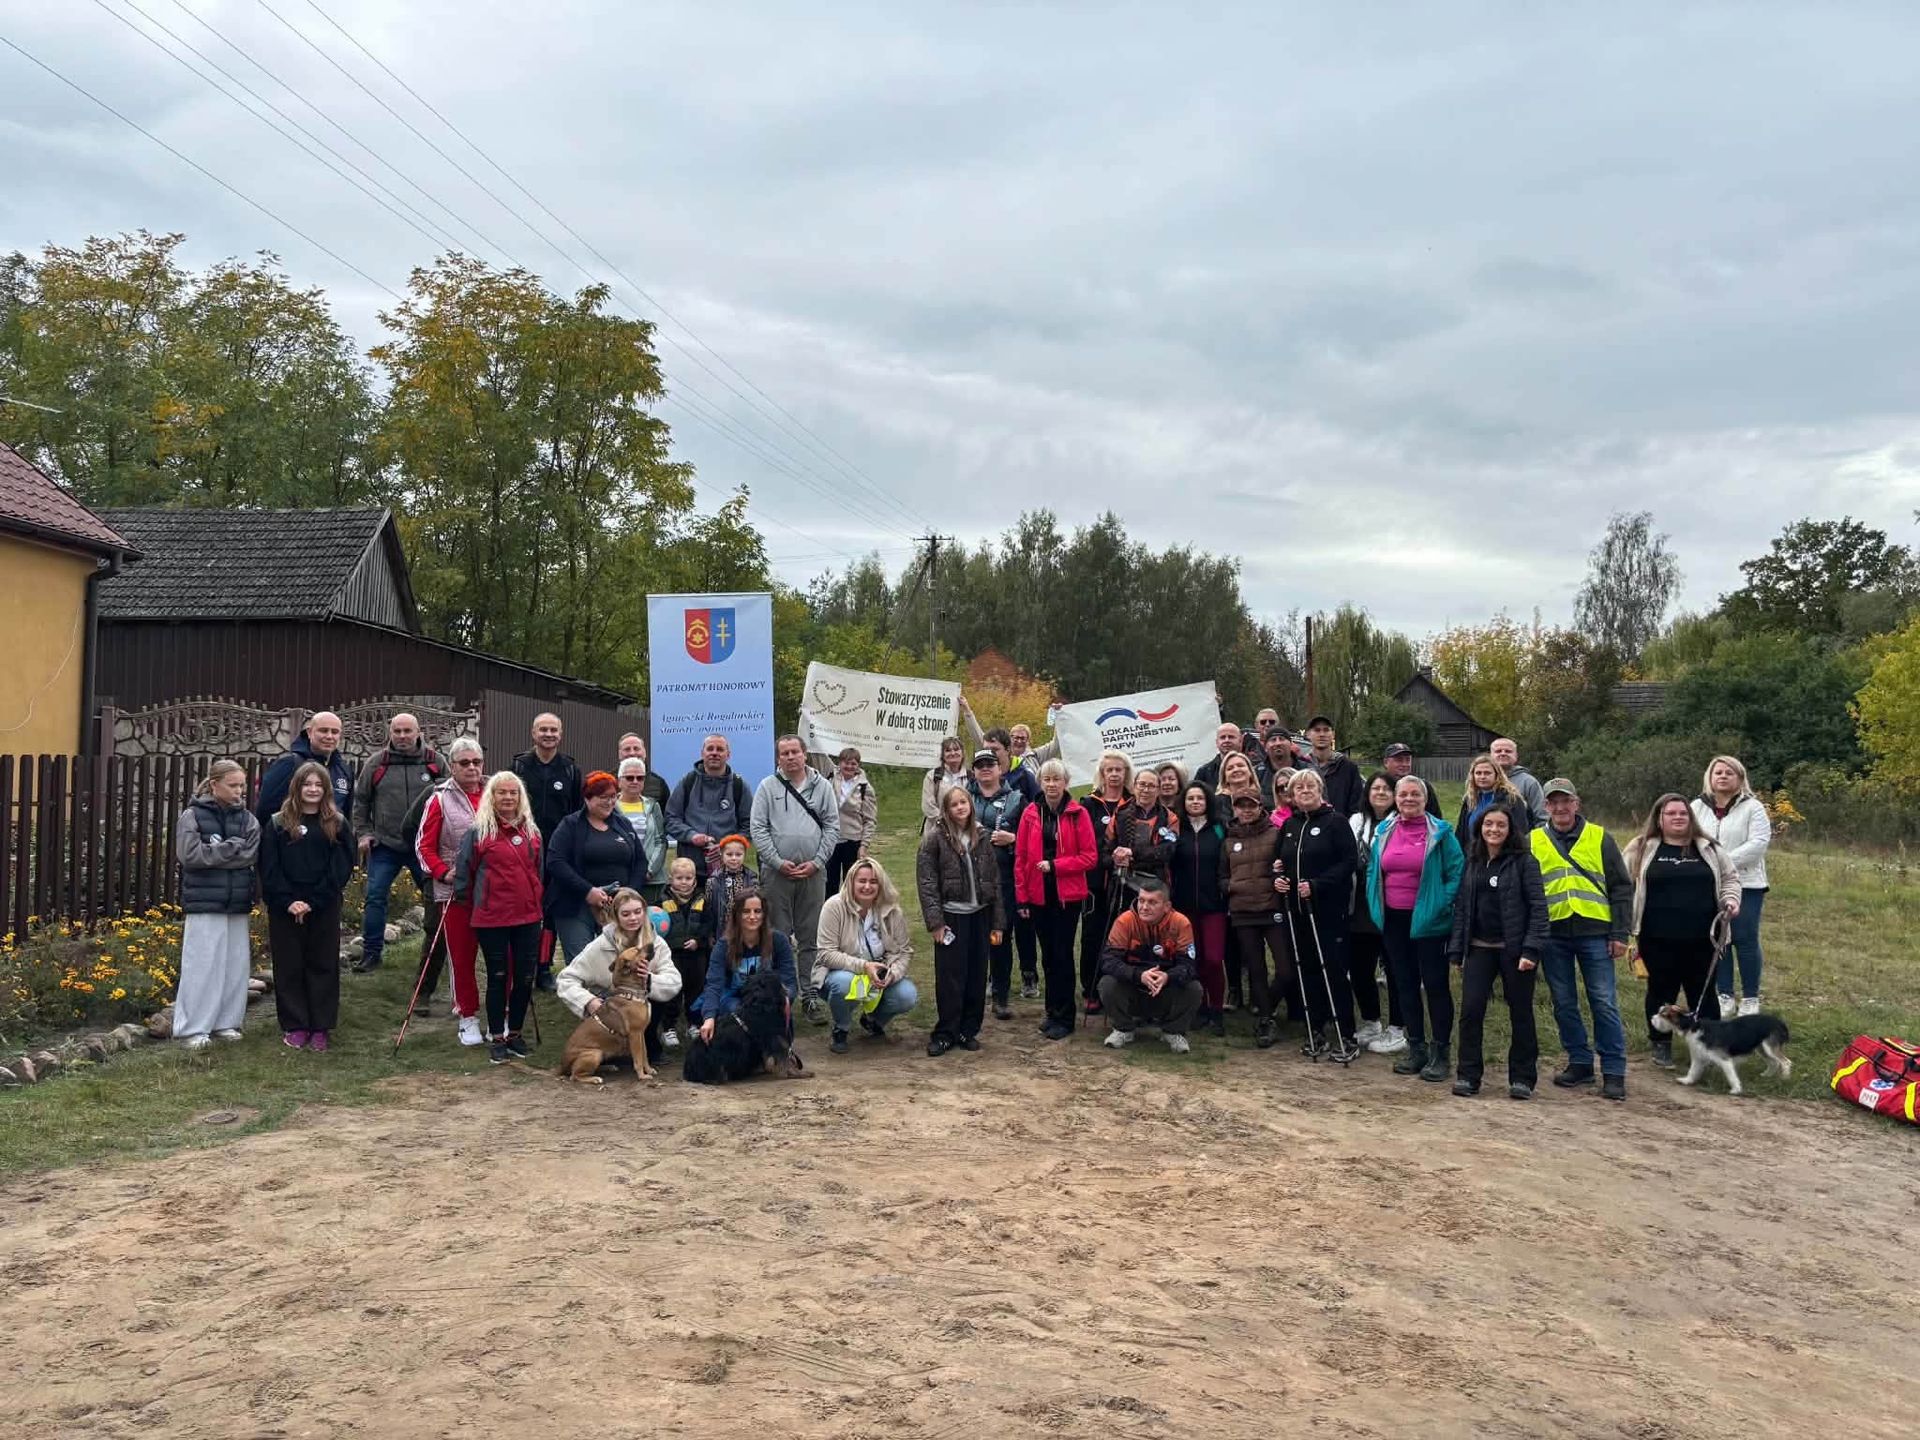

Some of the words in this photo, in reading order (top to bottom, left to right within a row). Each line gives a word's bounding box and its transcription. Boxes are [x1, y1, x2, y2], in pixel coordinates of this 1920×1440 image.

[656, 683, 708, 693] PATRONAT
[709, 680, 766, 691] HONOROWY
[877, 686, 951, 711] Stowarzyszenie
[875, 709, 887, 726] W
[887, 711, 915, 733] dobrą
[916, 715, 949, 735] stronę
[1101, 723, 1149, 737] LOKALNE
[1102, 725, 1181, 744] PARTNERSTWA
